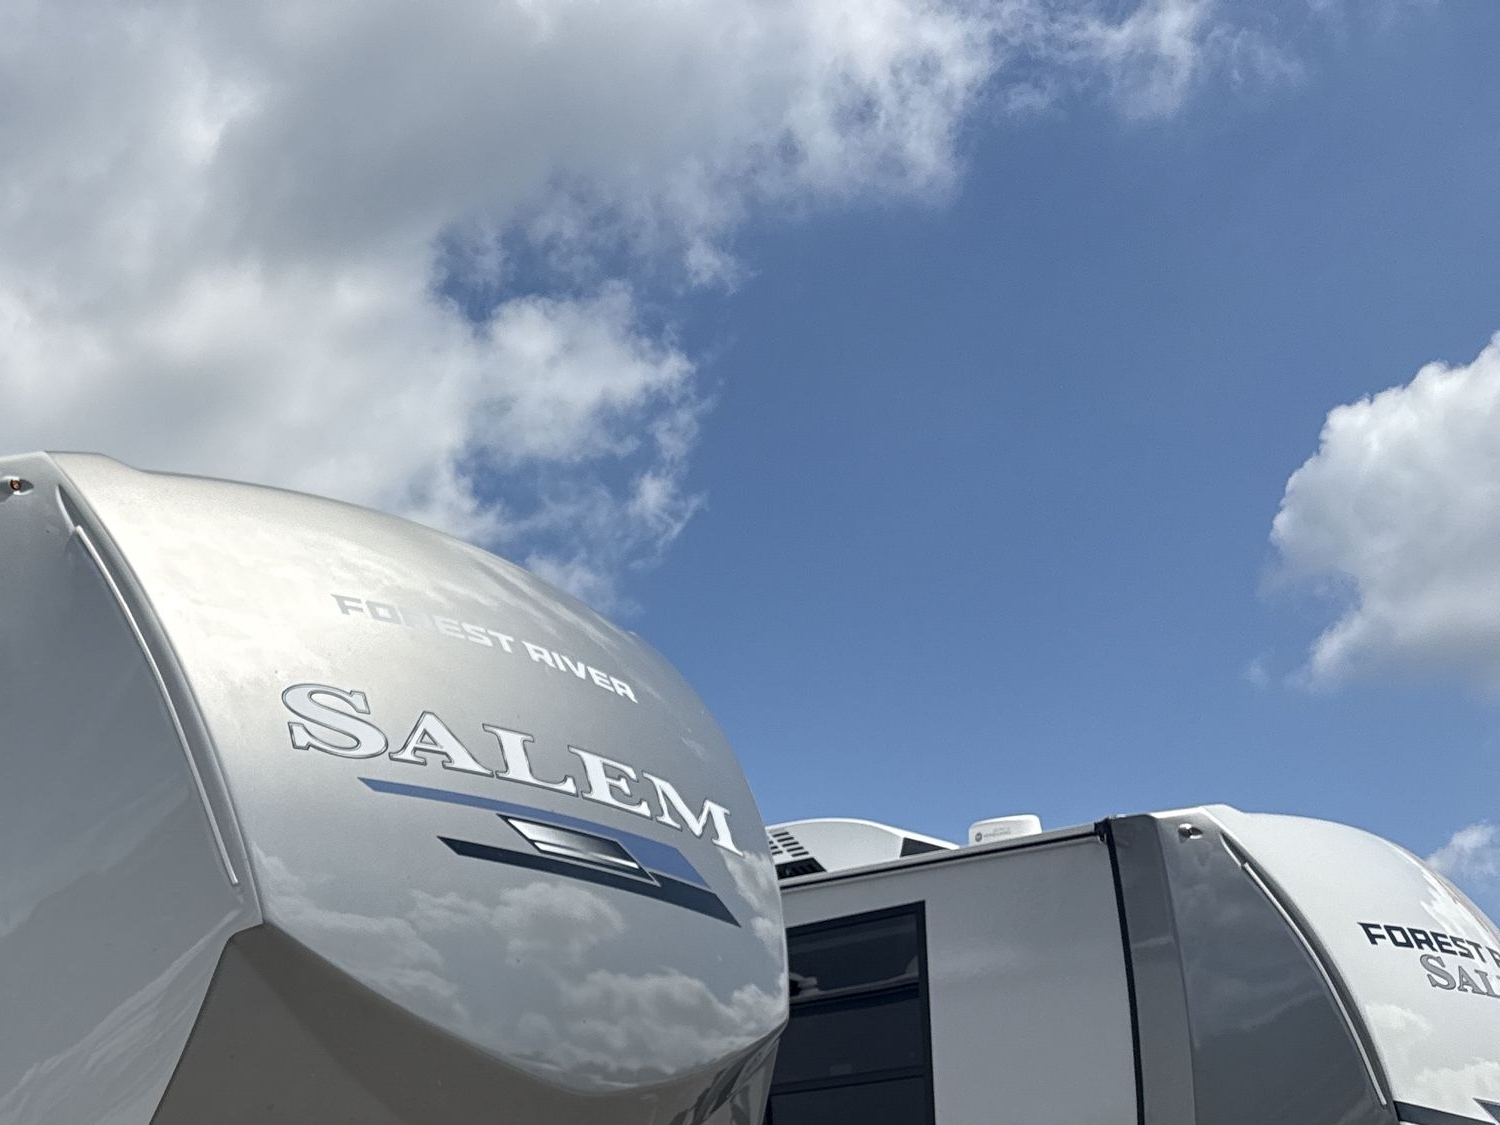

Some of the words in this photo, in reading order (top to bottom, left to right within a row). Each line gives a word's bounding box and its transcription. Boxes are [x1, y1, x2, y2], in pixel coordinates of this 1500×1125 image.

[331, 594, 514, 654] FOEST
[521, 640, 639, 704] RIVER
[281, 683, 745, 857] SALEM
[1356, 921, 1487, 964] FOREST
[1419, 953, 1500, 999] SAL
